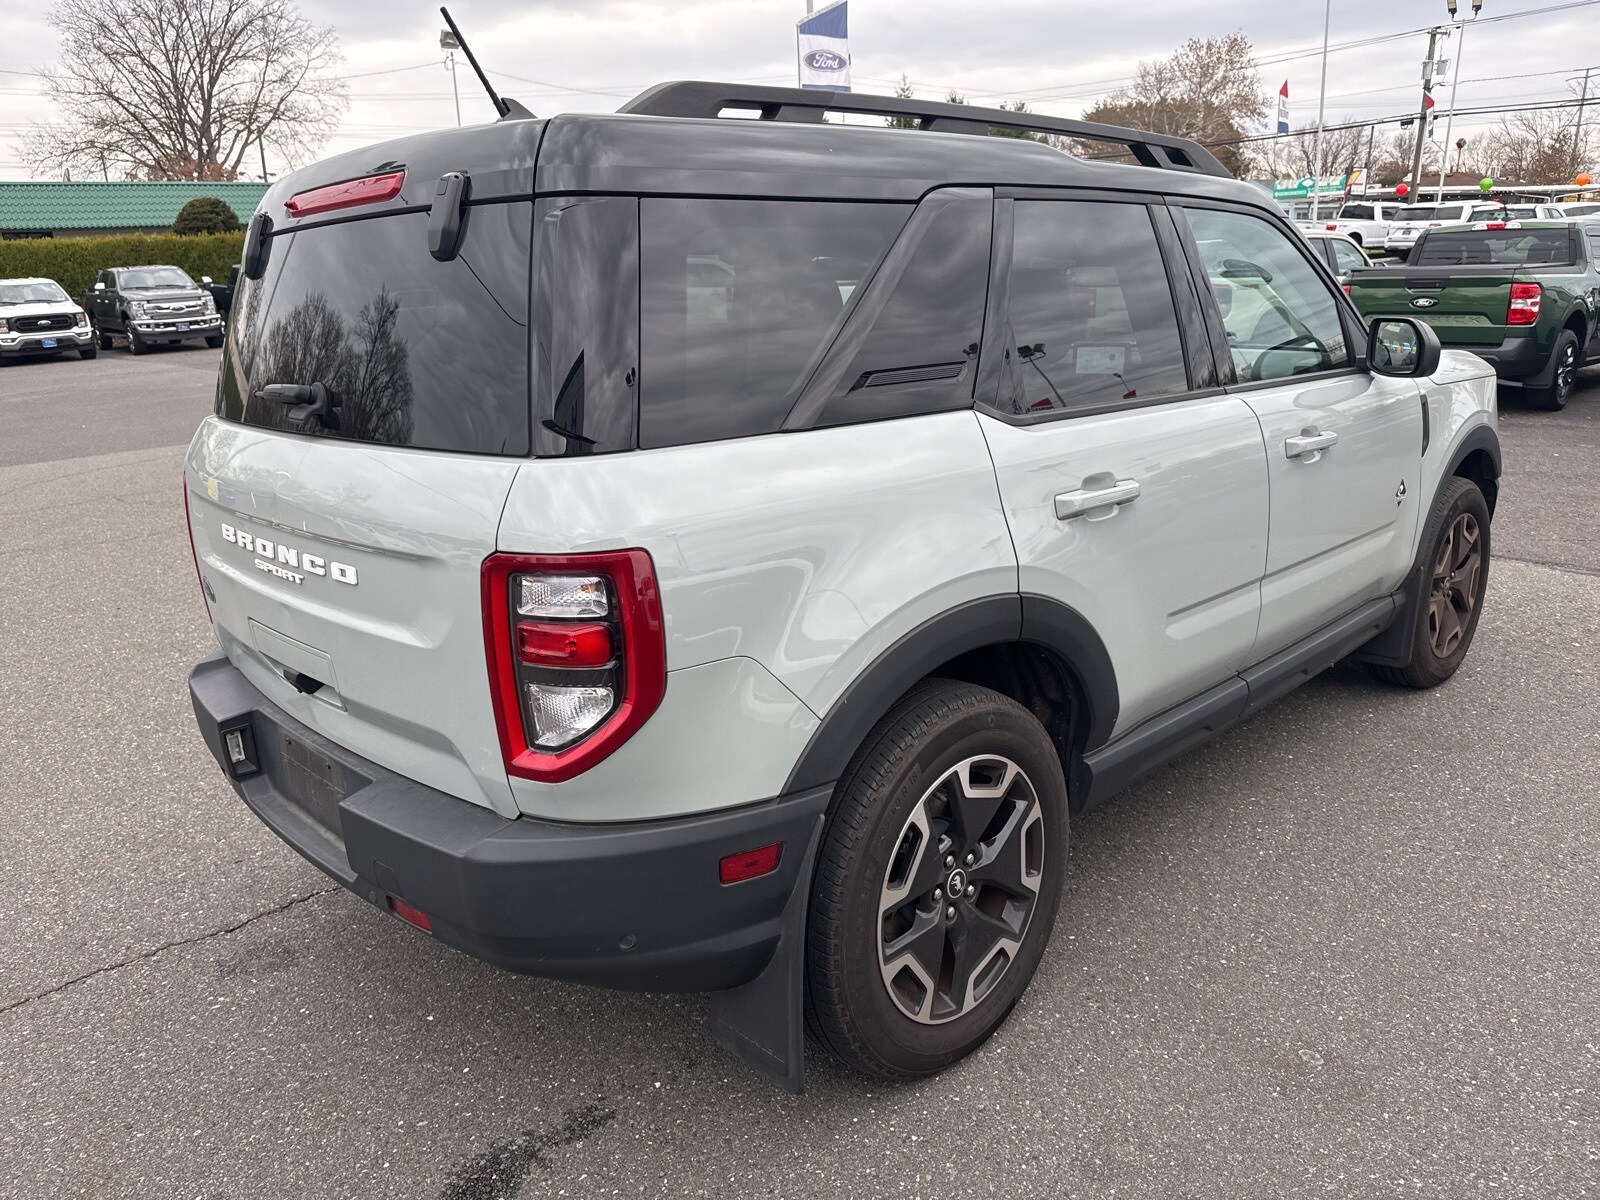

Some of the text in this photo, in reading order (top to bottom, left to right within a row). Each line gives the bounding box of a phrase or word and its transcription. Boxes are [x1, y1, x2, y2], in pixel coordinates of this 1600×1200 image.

[813, 53, 840, 68] Ford
[221, 523, 358, 586] BRONCO
[254, 558, 305, 584] SPORT
